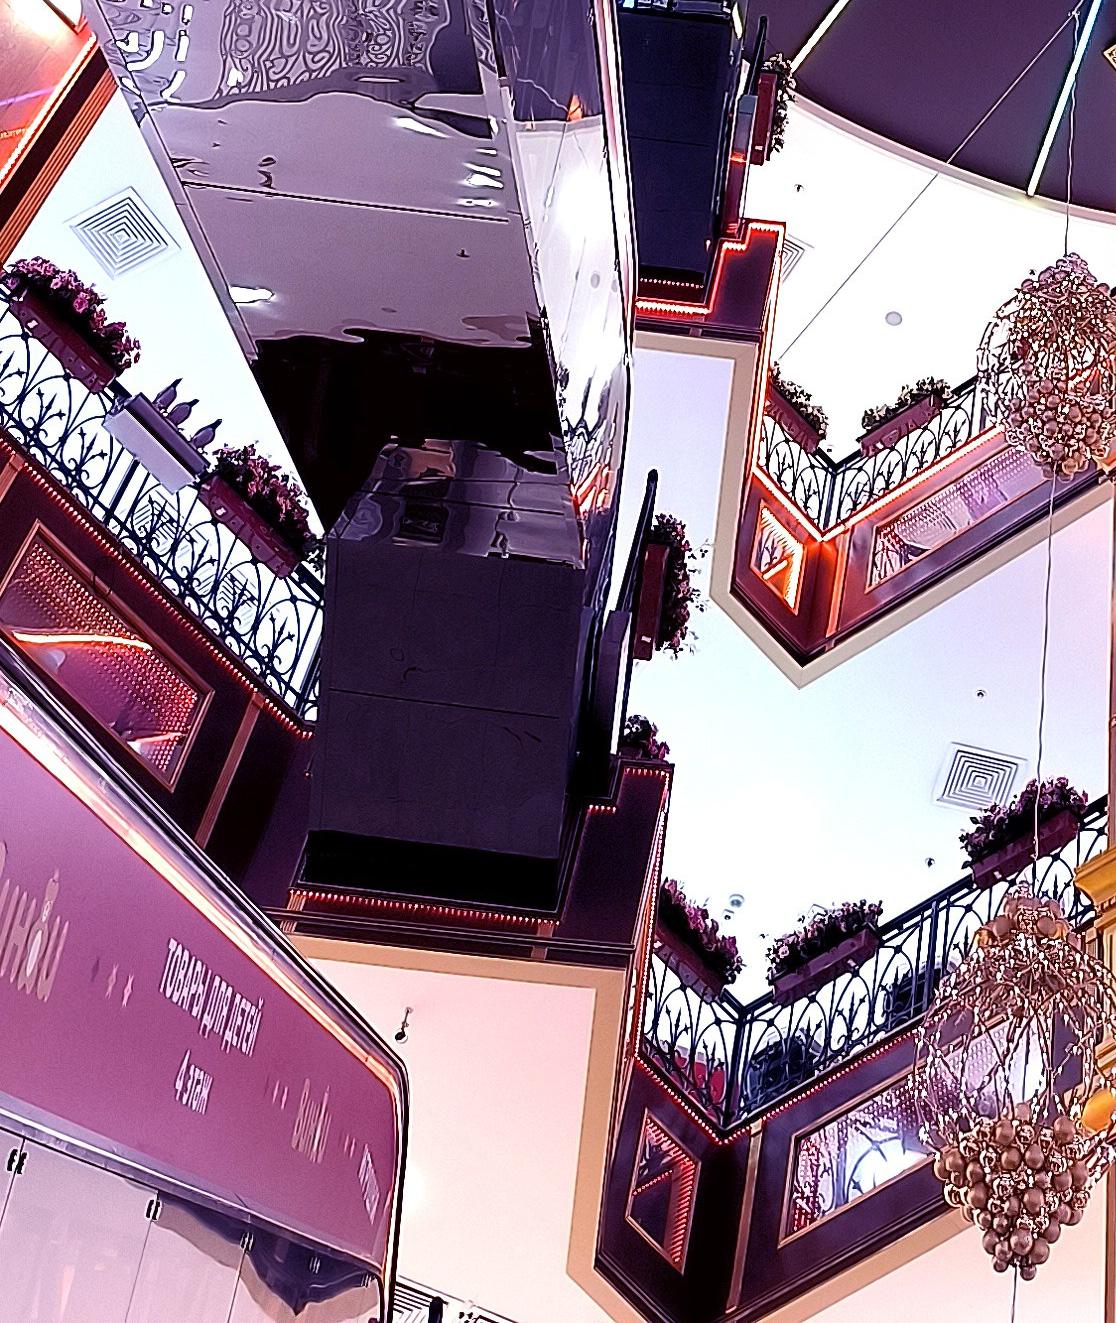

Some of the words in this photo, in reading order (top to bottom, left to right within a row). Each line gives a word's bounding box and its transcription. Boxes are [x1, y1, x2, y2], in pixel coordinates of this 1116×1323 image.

[159, 937, 213, 1020] ТОВАРЫ
[199, 975, 233, 1040] ДЛЯ
[221, 993, 263, 1058] ДЕТЕЙ
[175, 1049, 191, 1101] 4
[182, 1064, 215, 1115] этаж
